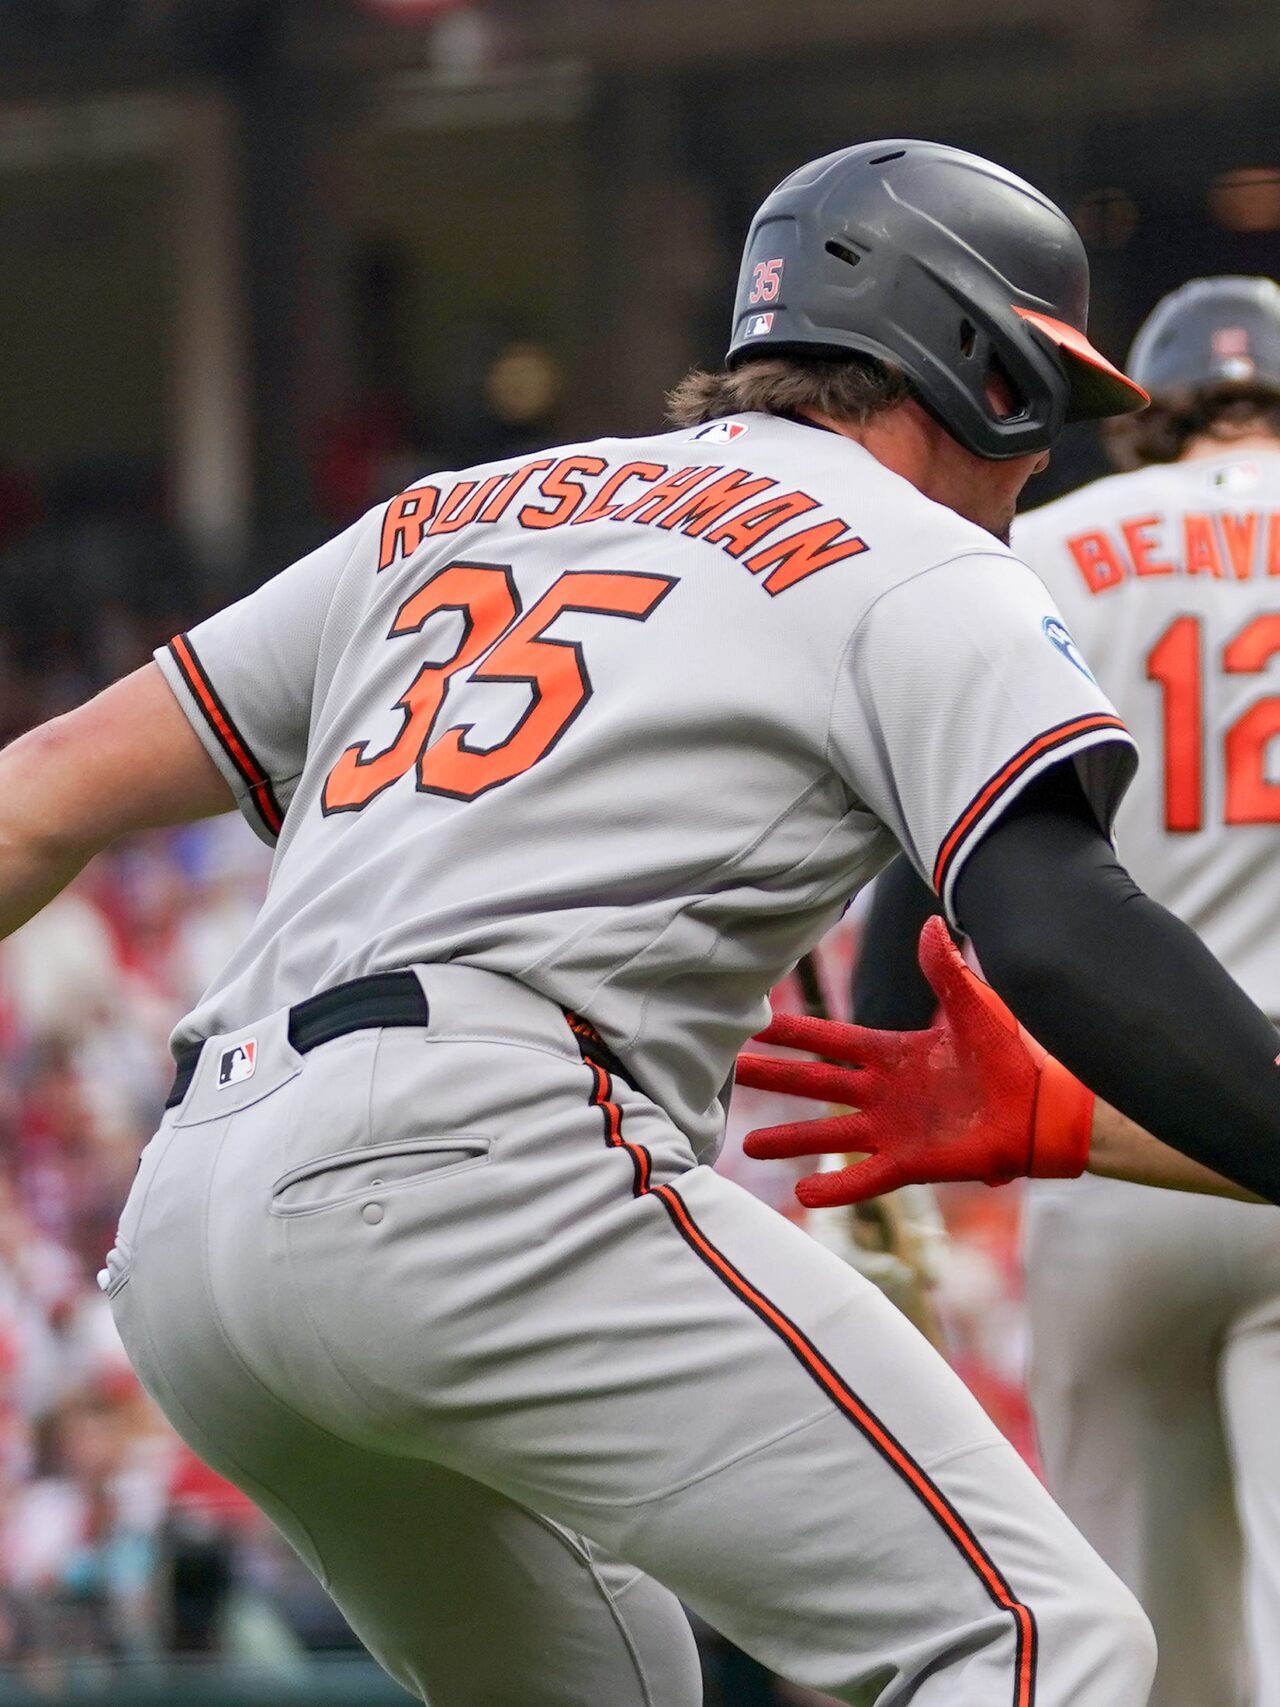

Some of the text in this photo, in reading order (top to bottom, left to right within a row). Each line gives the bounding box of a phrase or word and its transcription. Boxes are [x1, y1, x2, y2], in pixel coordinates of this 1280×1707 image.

[749, 258, 784, 304] 35
[377, 456, 870, 597] RUTSCHMAN
[320, 560, 681, 818] 35
